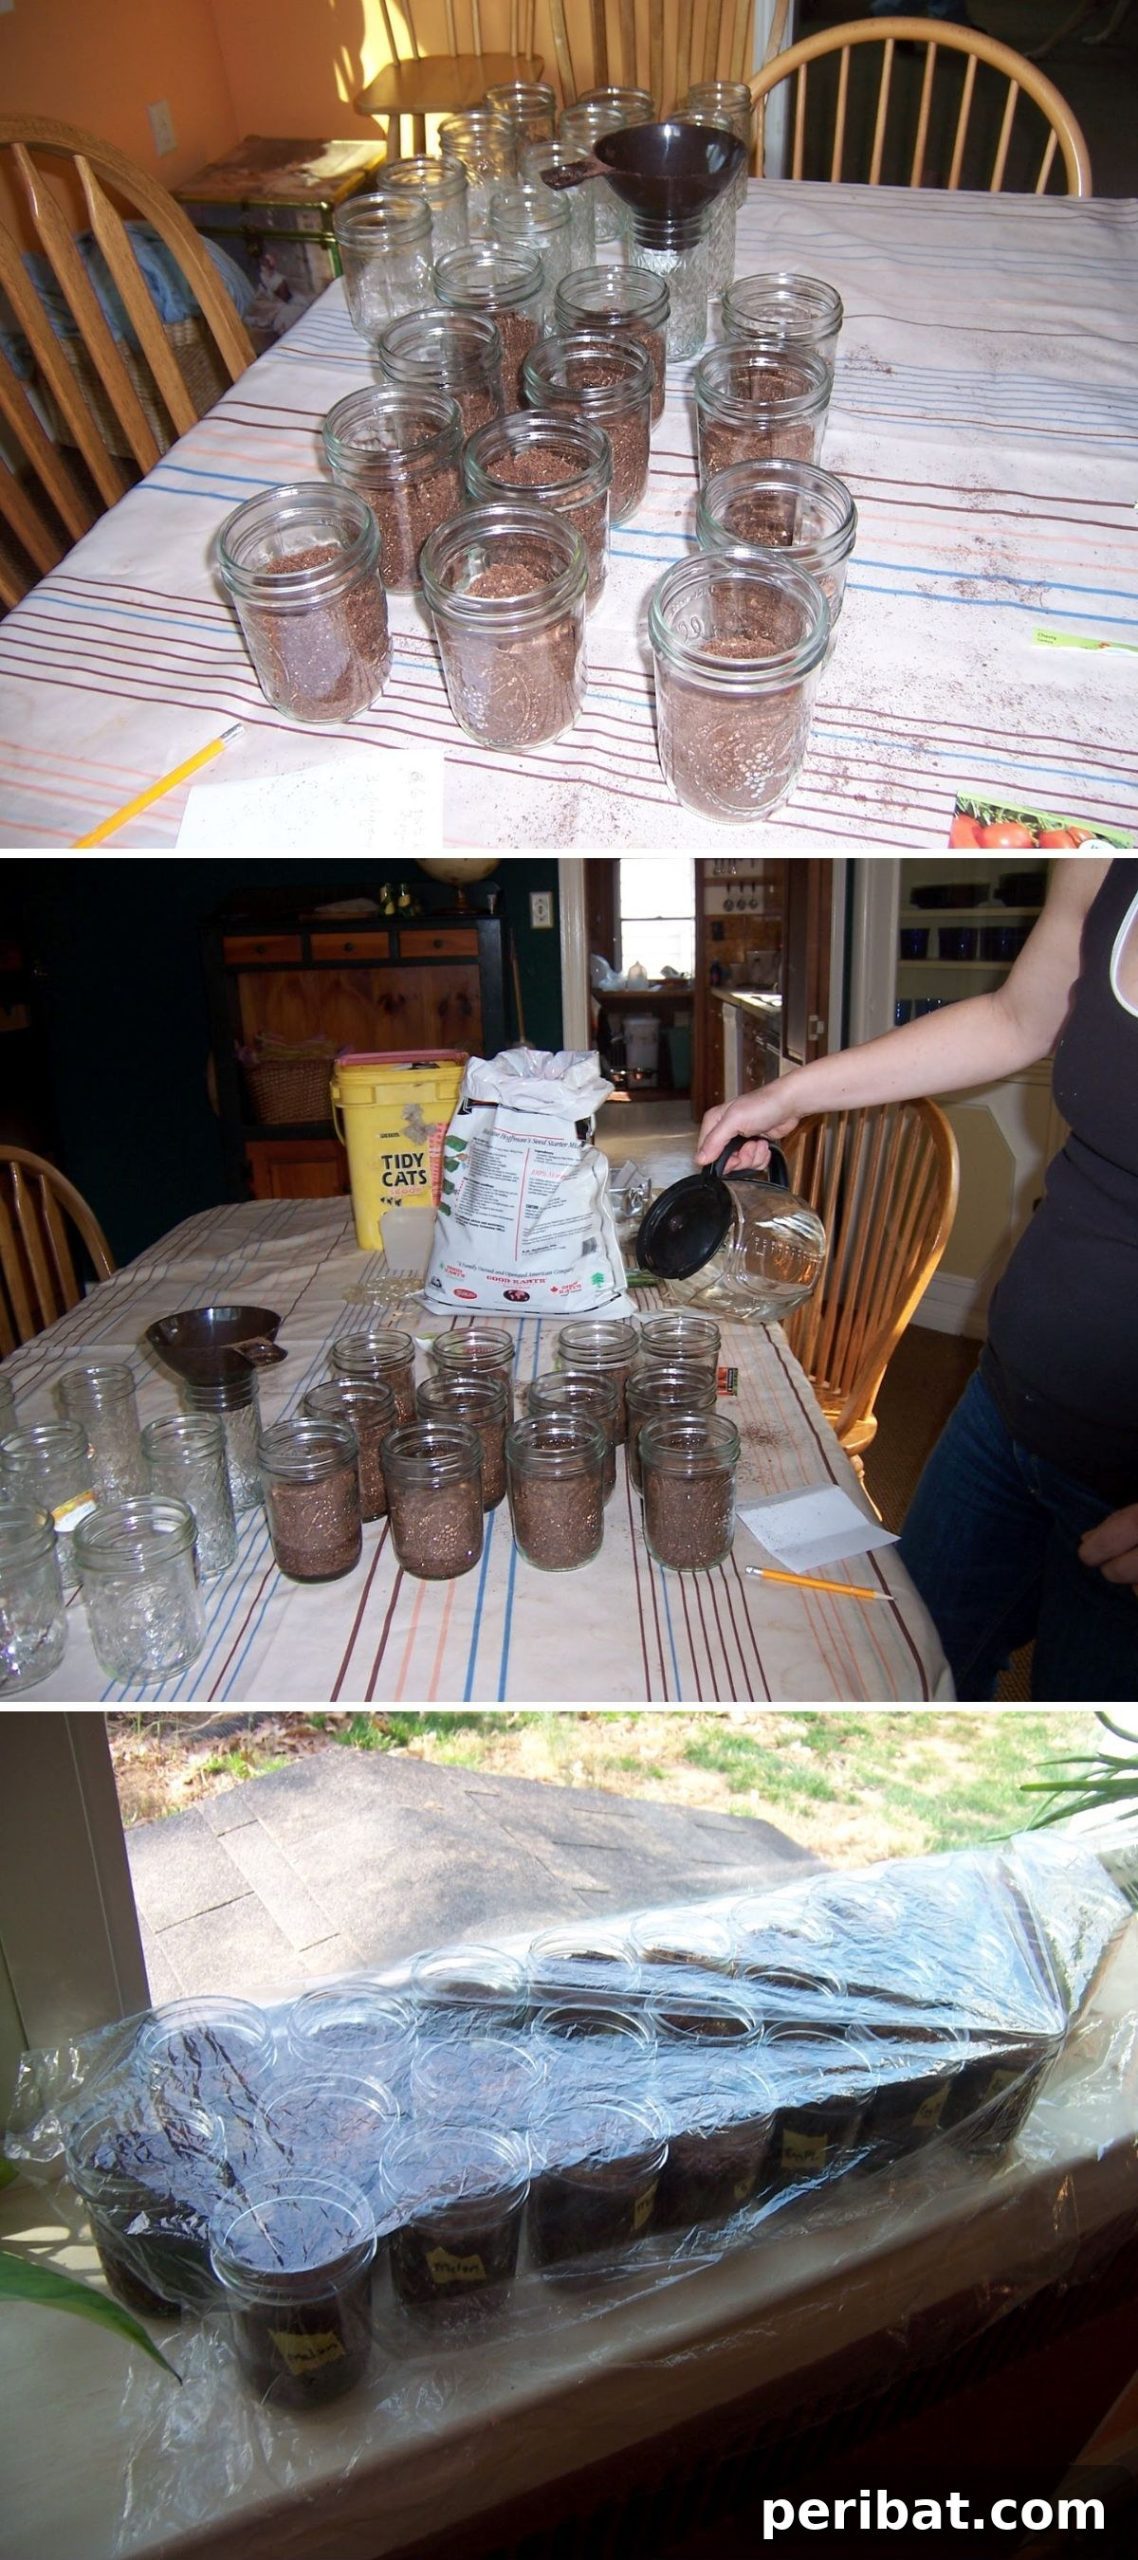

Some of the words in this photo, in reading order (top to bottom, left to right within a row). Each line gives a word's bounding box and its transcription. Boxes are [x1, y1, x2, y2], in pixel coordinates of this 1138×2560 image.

[381, 1152, 424, 1170] TIDY
[382, 1169, 427, 1187] CATS
[486, 1275, 511, 1284] GOOD
